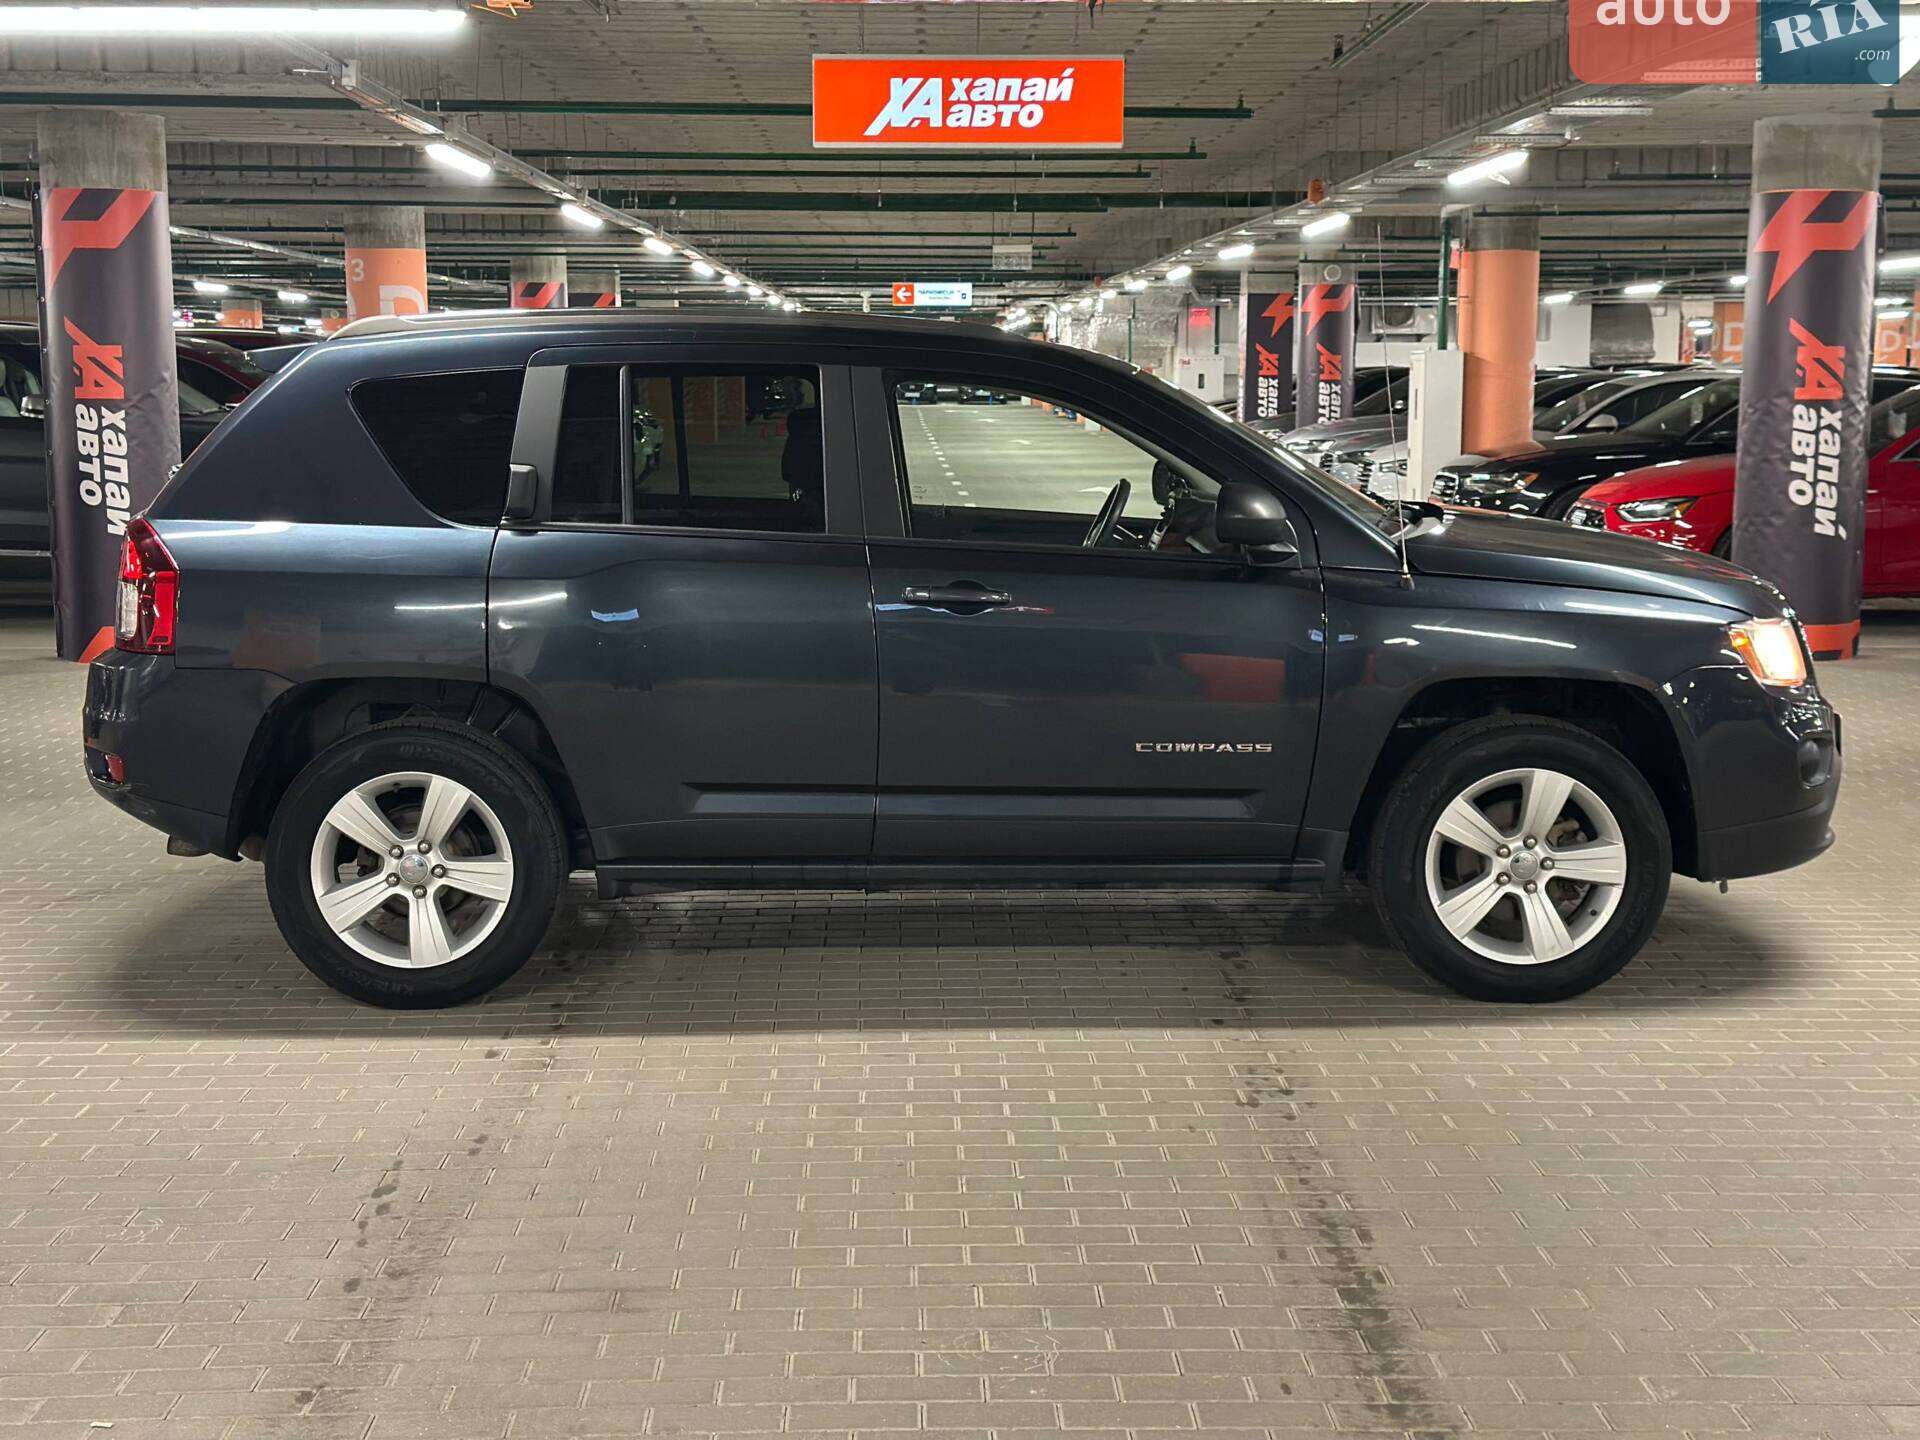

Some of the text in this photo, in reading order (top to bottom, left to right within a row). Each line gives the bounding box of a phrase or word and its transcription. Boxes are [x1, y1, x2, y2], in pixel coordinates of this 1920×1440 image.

[948, 67, 1076, 102] хапай
[946, 103, 1044, 128] авто
[1257, 377, 1268, 417] авто
[1268, 378, 1279, 417] хапа
[75, 403, 103, 506] авто
[1788, 404, 1817, 506] авто
[1814, 406, 1847, 541] хапай
[1135, 742, 1273, 753] COMPASS
